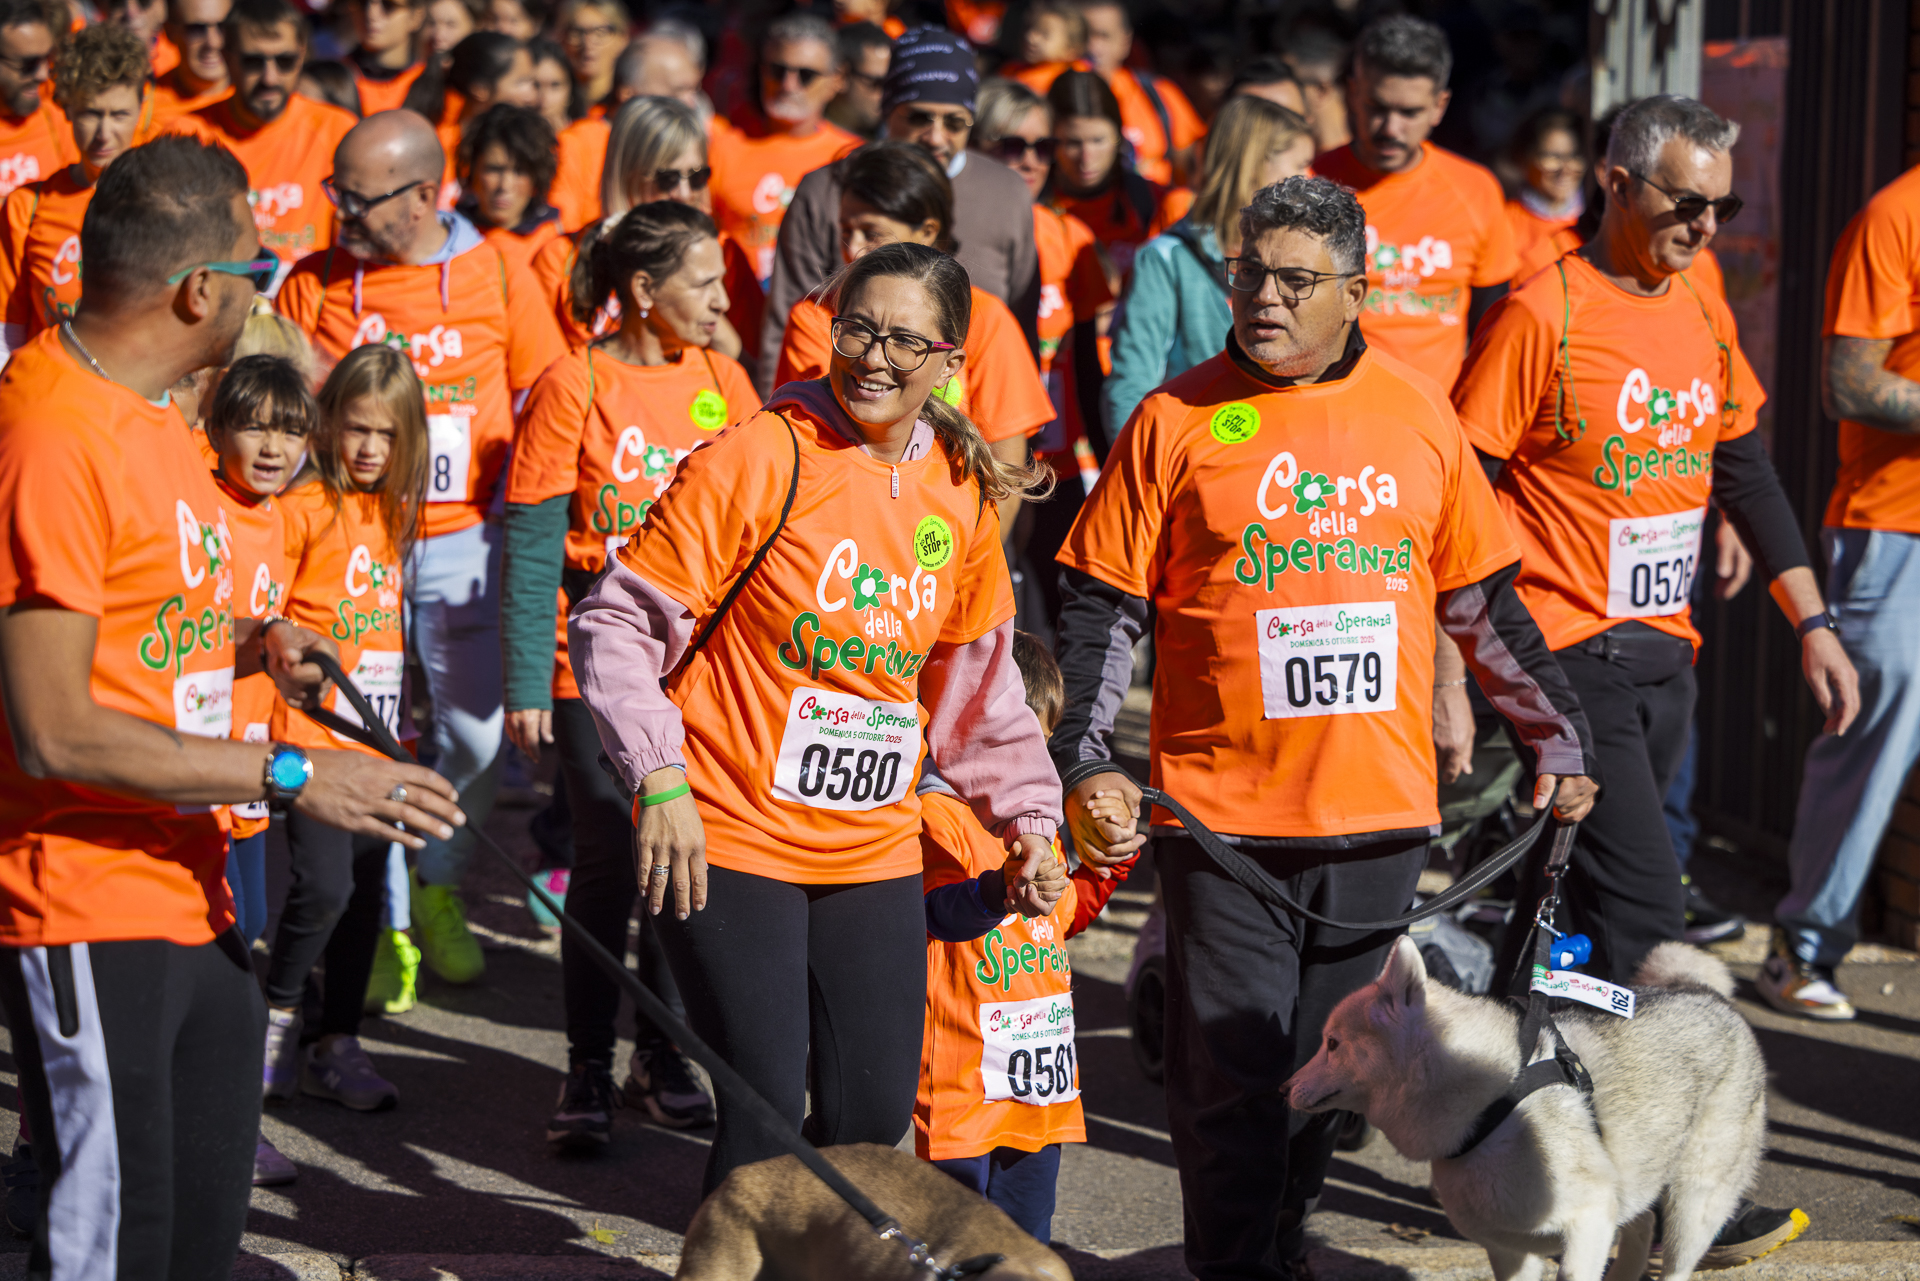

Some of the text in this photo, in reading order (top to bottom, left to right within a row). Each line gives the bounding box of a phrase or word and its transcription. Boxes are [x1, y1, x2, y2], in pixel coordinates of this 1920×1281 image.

[1616, 367, 1717, 434] Corsa
[1221, 418, 1243, 435] STOP
[1231, 415, 1246, 427] PIT
[611, 425, 705, 484] Cor
[1257, 451, 1398, 521] Corsa
[924, 530, 936, 545] PIT
[1309, 510, 1358, 538] della
[922, 539, 942, 557] STOP
[1234, 522, 1413, 593] Speranza
[816, 538, 938, 621] Corsa
[1385, 576, 1408, 592] 2025
[864, 609, 903, 639] della
[1267, 610, 1392, 640] Corsa della Speranza
[1290, 639, 1324, 648] DOMENICA
[1331, 636, 1359, 645] OTTOBRE
[1360, 635, 1375, 644] 2025
[1284, 651, 1381, 708] 0579
[798, 696, 849, 726] Corsa
[850, 710, 866, 721] della
[818, 726, 903, 744] DOMENICA 5 OTTOBRE 2025
[798, 743, 902, 802] 0580
[1610, 989, 1630, 1013] 162
[1007, 1042, 1075, 1098] 0581
